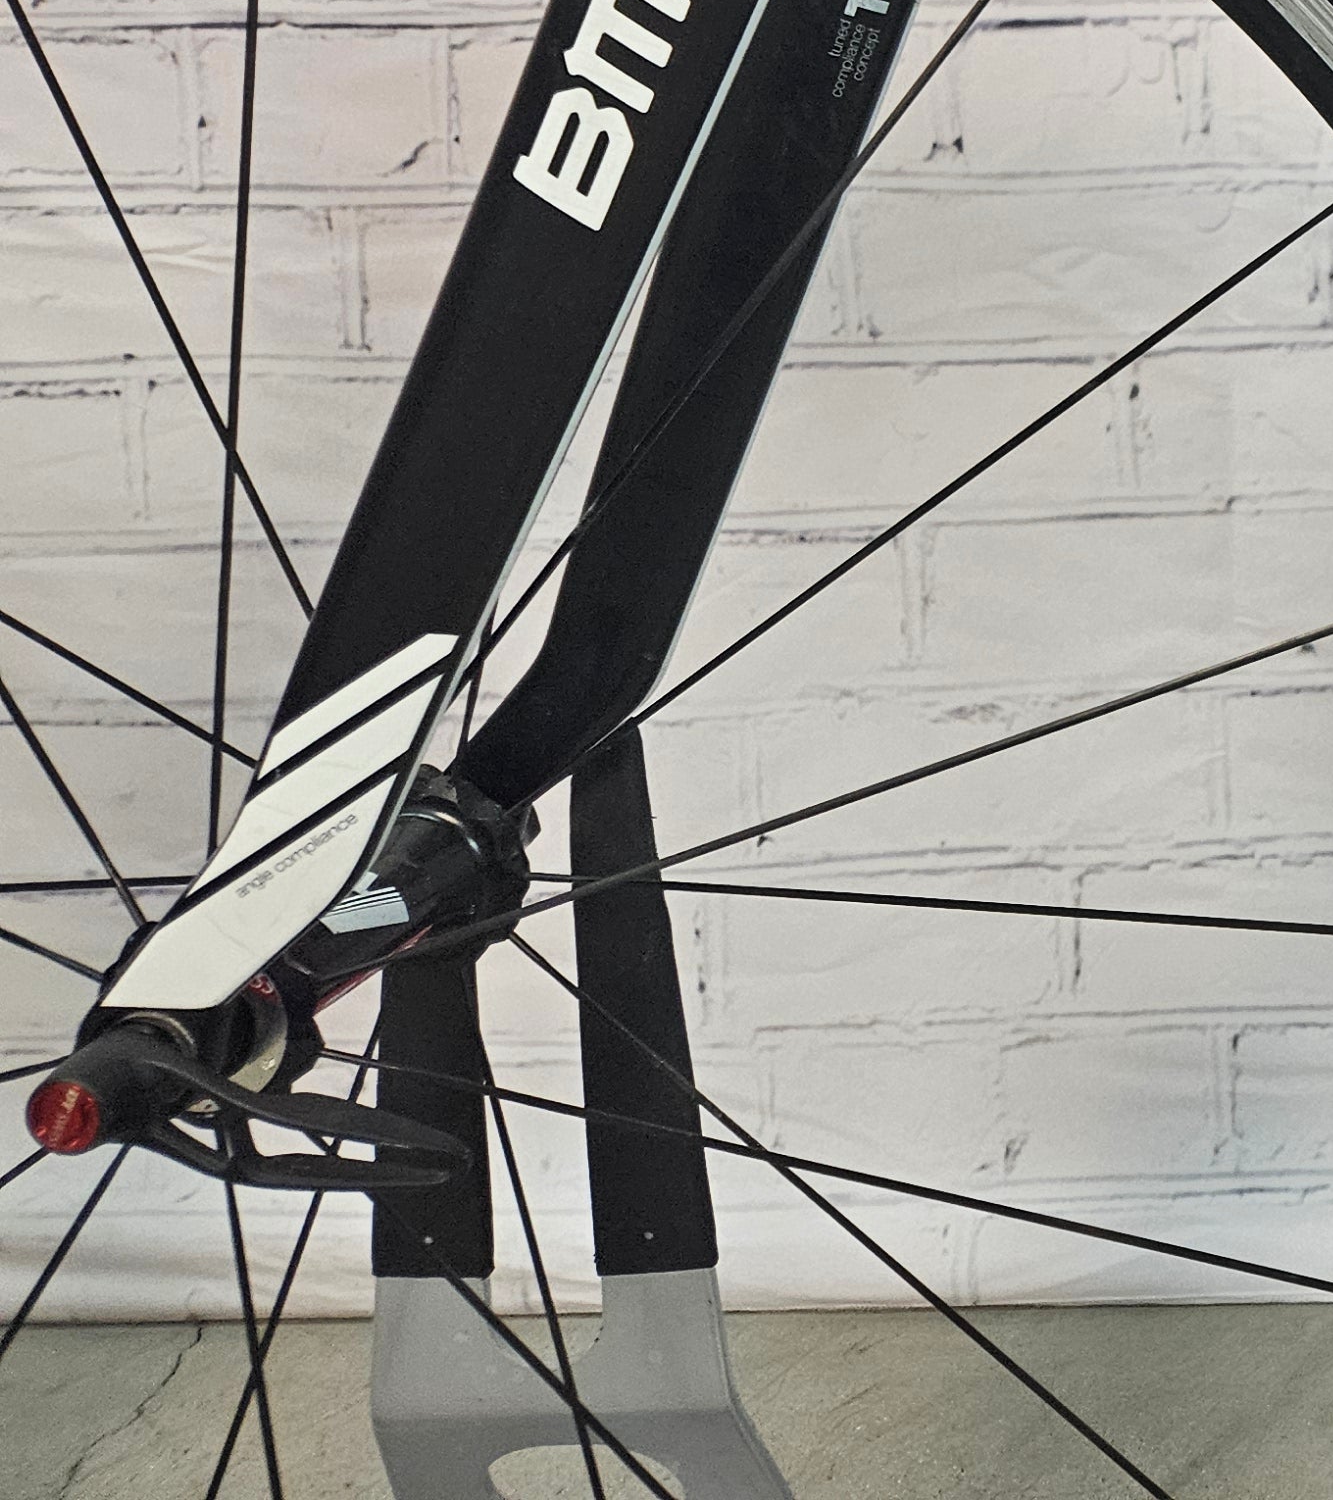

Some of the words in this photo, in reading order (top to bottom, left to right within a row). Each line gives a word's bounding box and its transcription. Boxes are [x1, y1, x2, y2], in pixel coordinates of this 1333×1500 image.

[828, 18, 852, 58] tuned
[832, 23, 867, 98] compliance
[854, 26, 881, 82] concept
[235, 870, 274, 898] angle
[274, 813, 358, 873] compliance
